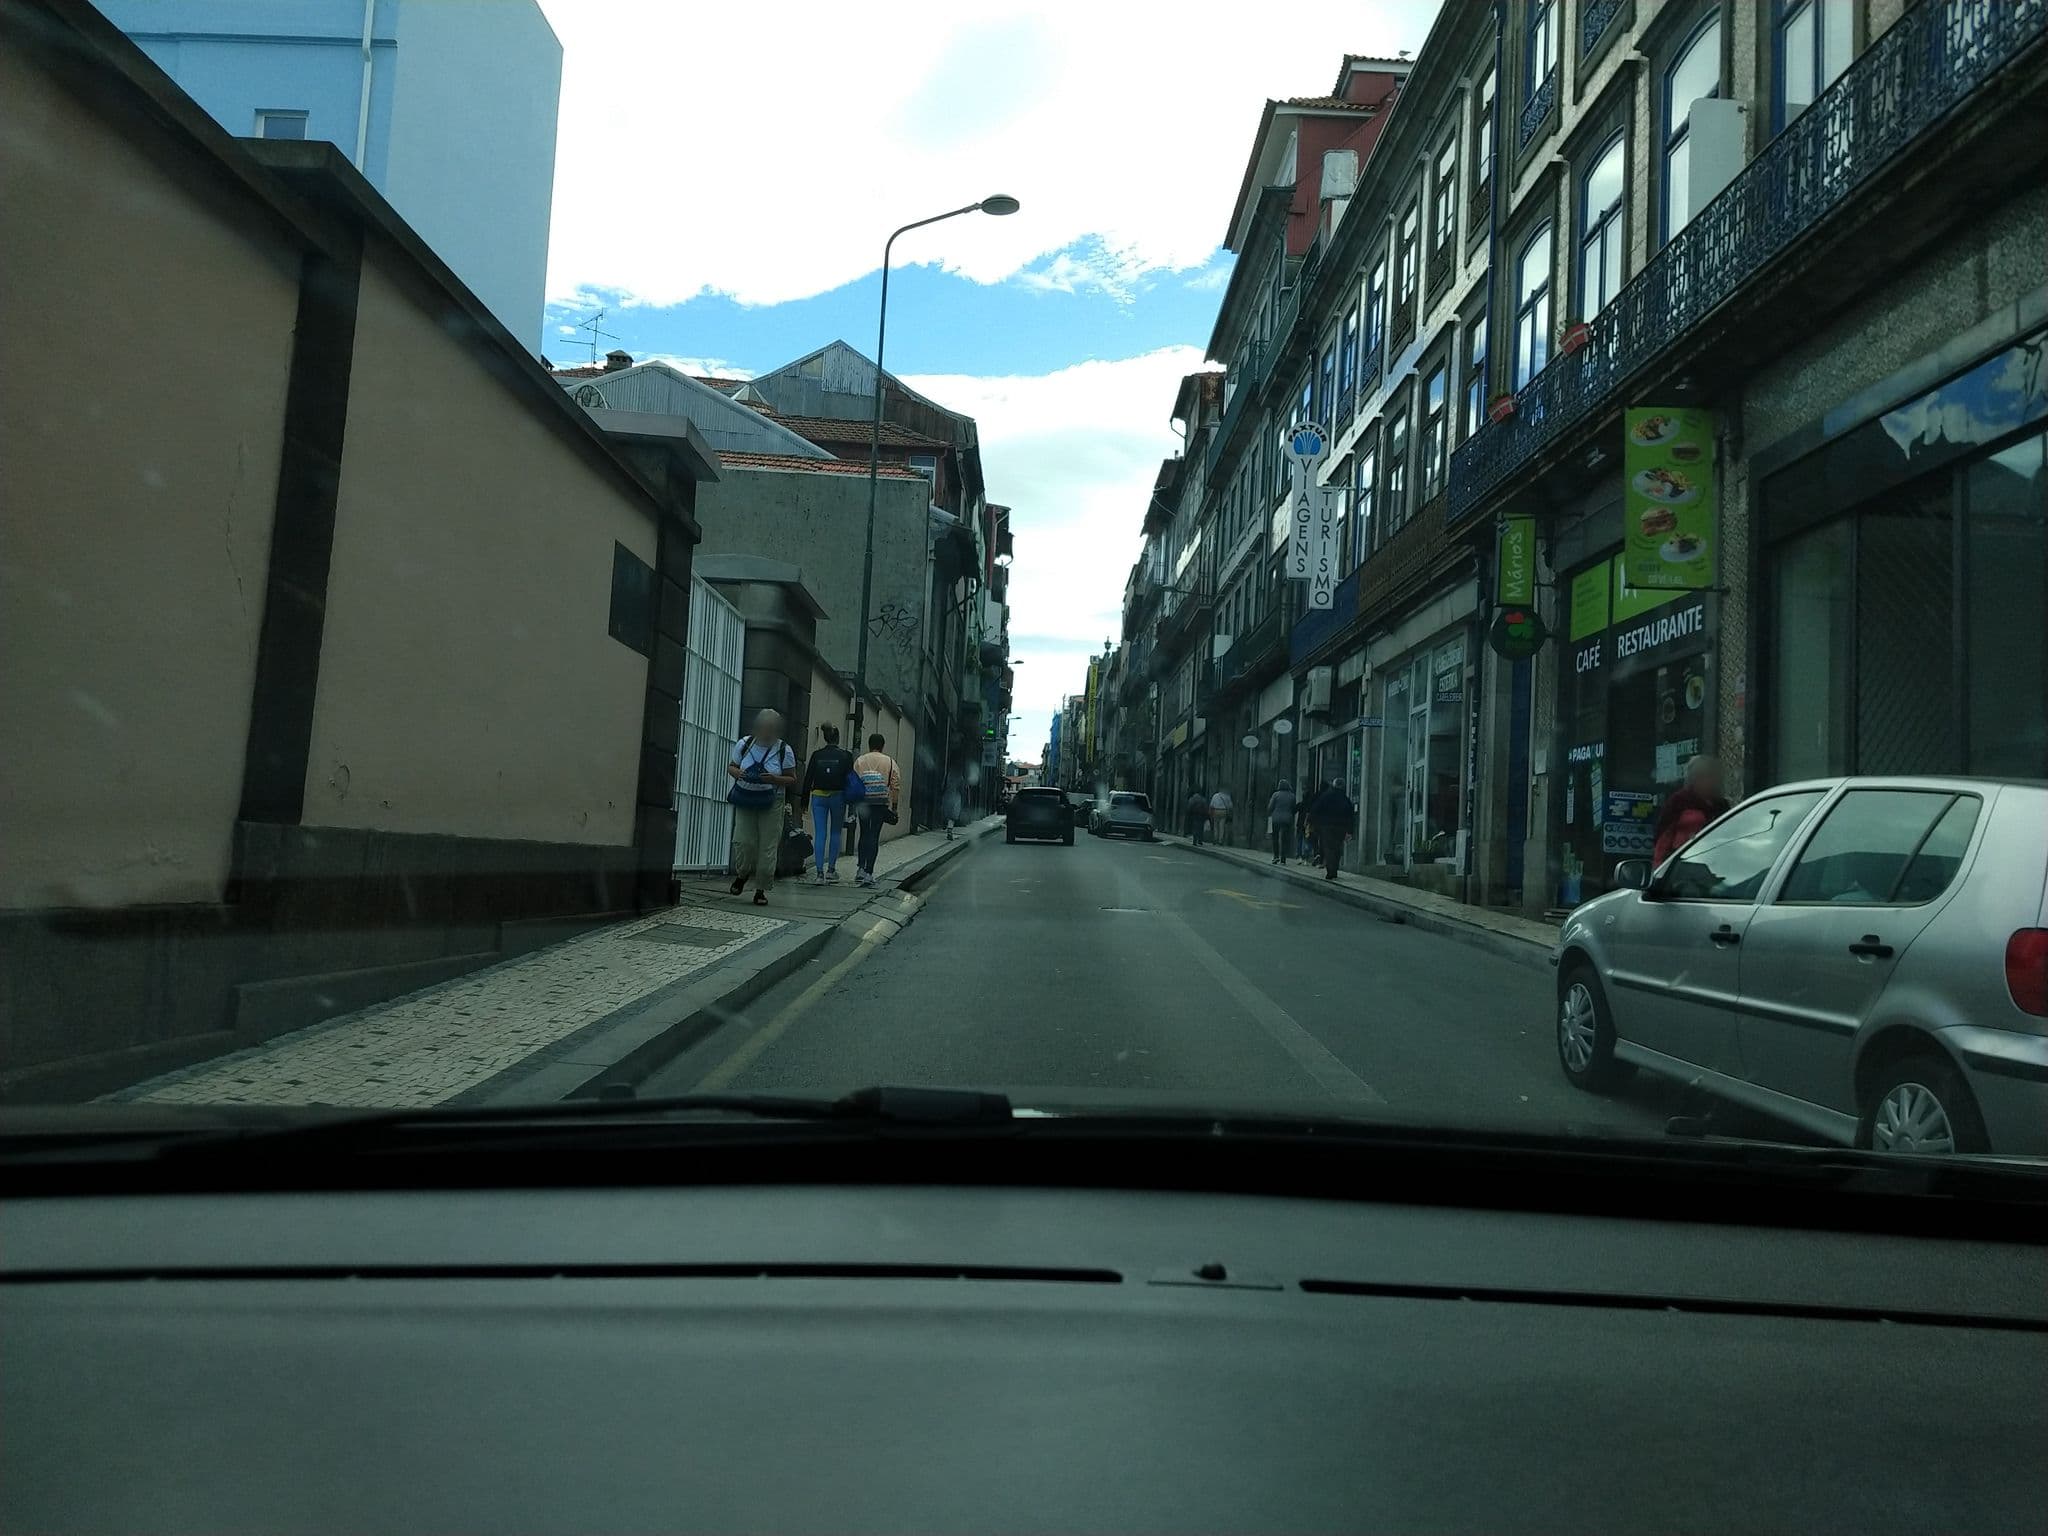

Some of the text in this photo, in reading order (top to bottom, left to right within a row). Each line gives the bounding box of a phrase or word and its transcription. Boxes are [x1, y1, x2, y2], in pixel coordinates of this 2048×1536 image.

[1288, 424, 1327, 442] PAXTUR
[1296, 458, 1311, 573] VIAGENS
[1314, 491, 1332, 605] TURISMO
[1576, 604, 1703, 673] CAFÉ RESTAURANTE
